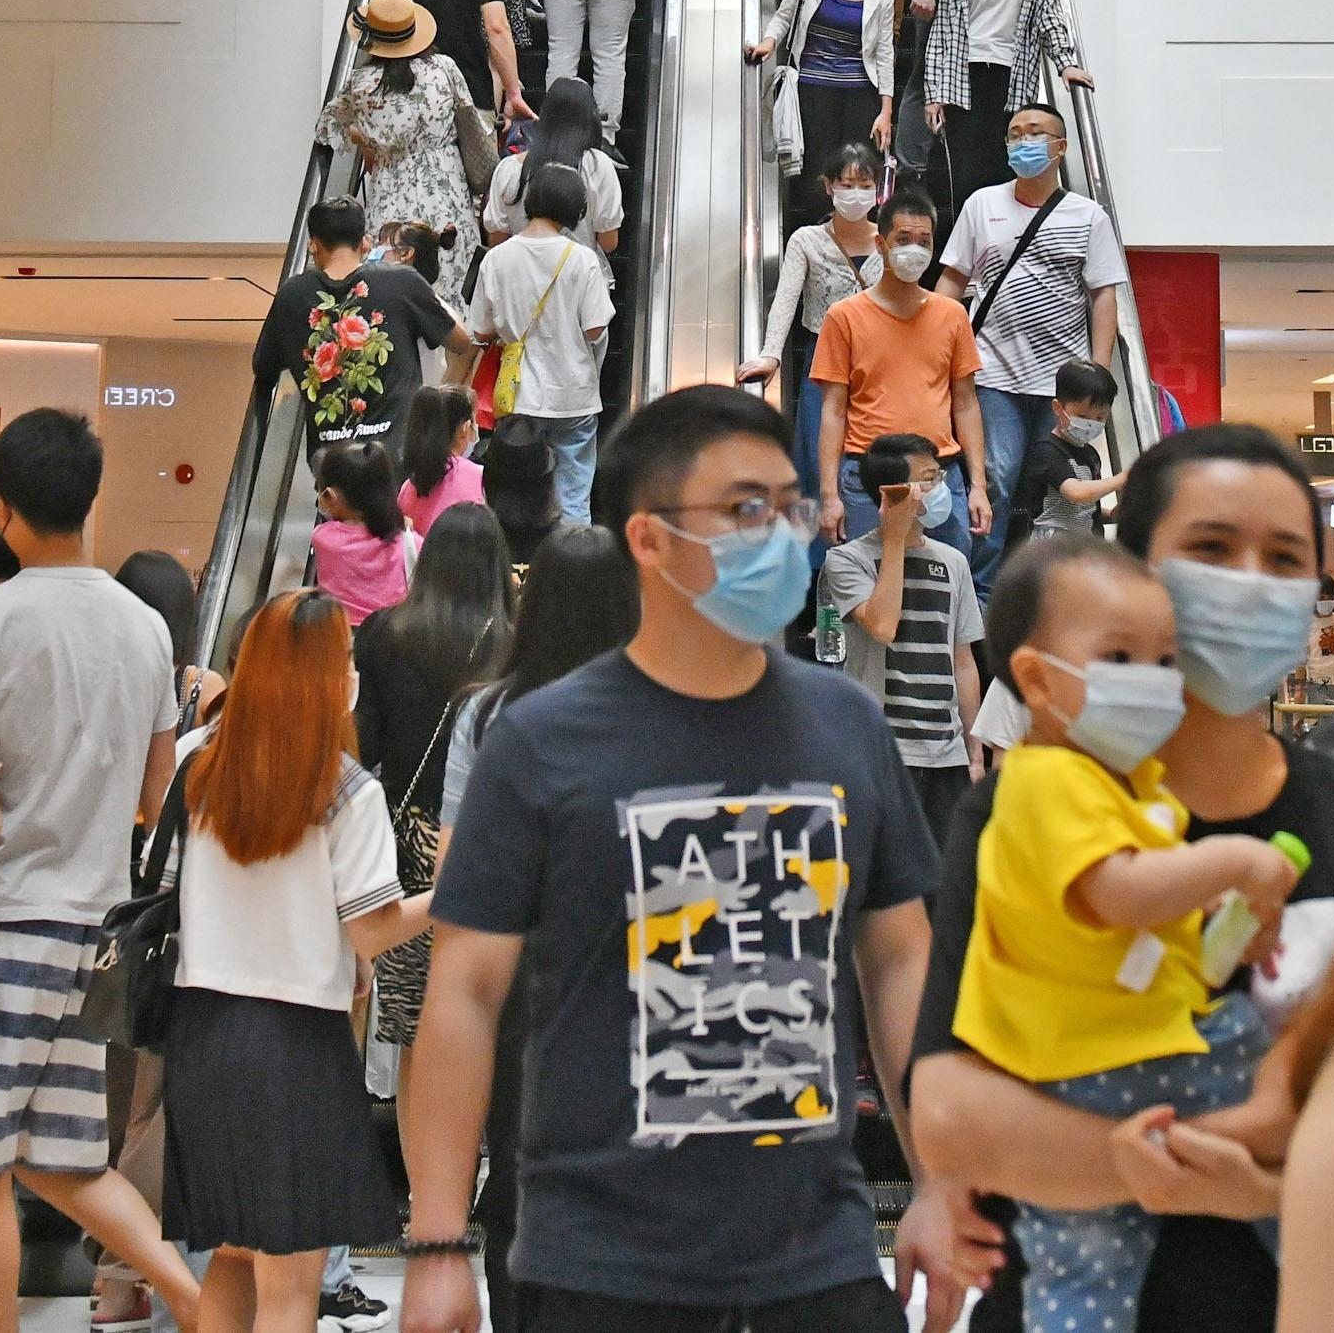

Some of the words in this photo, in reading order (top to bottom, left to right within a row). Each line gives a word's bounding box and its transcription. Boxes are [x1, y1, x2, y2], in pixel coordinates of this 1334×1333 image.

[678, 830, 811, 885] ATH
[680, 910, 812, 966] LET
[690, 978, 815, 1036] ICS
